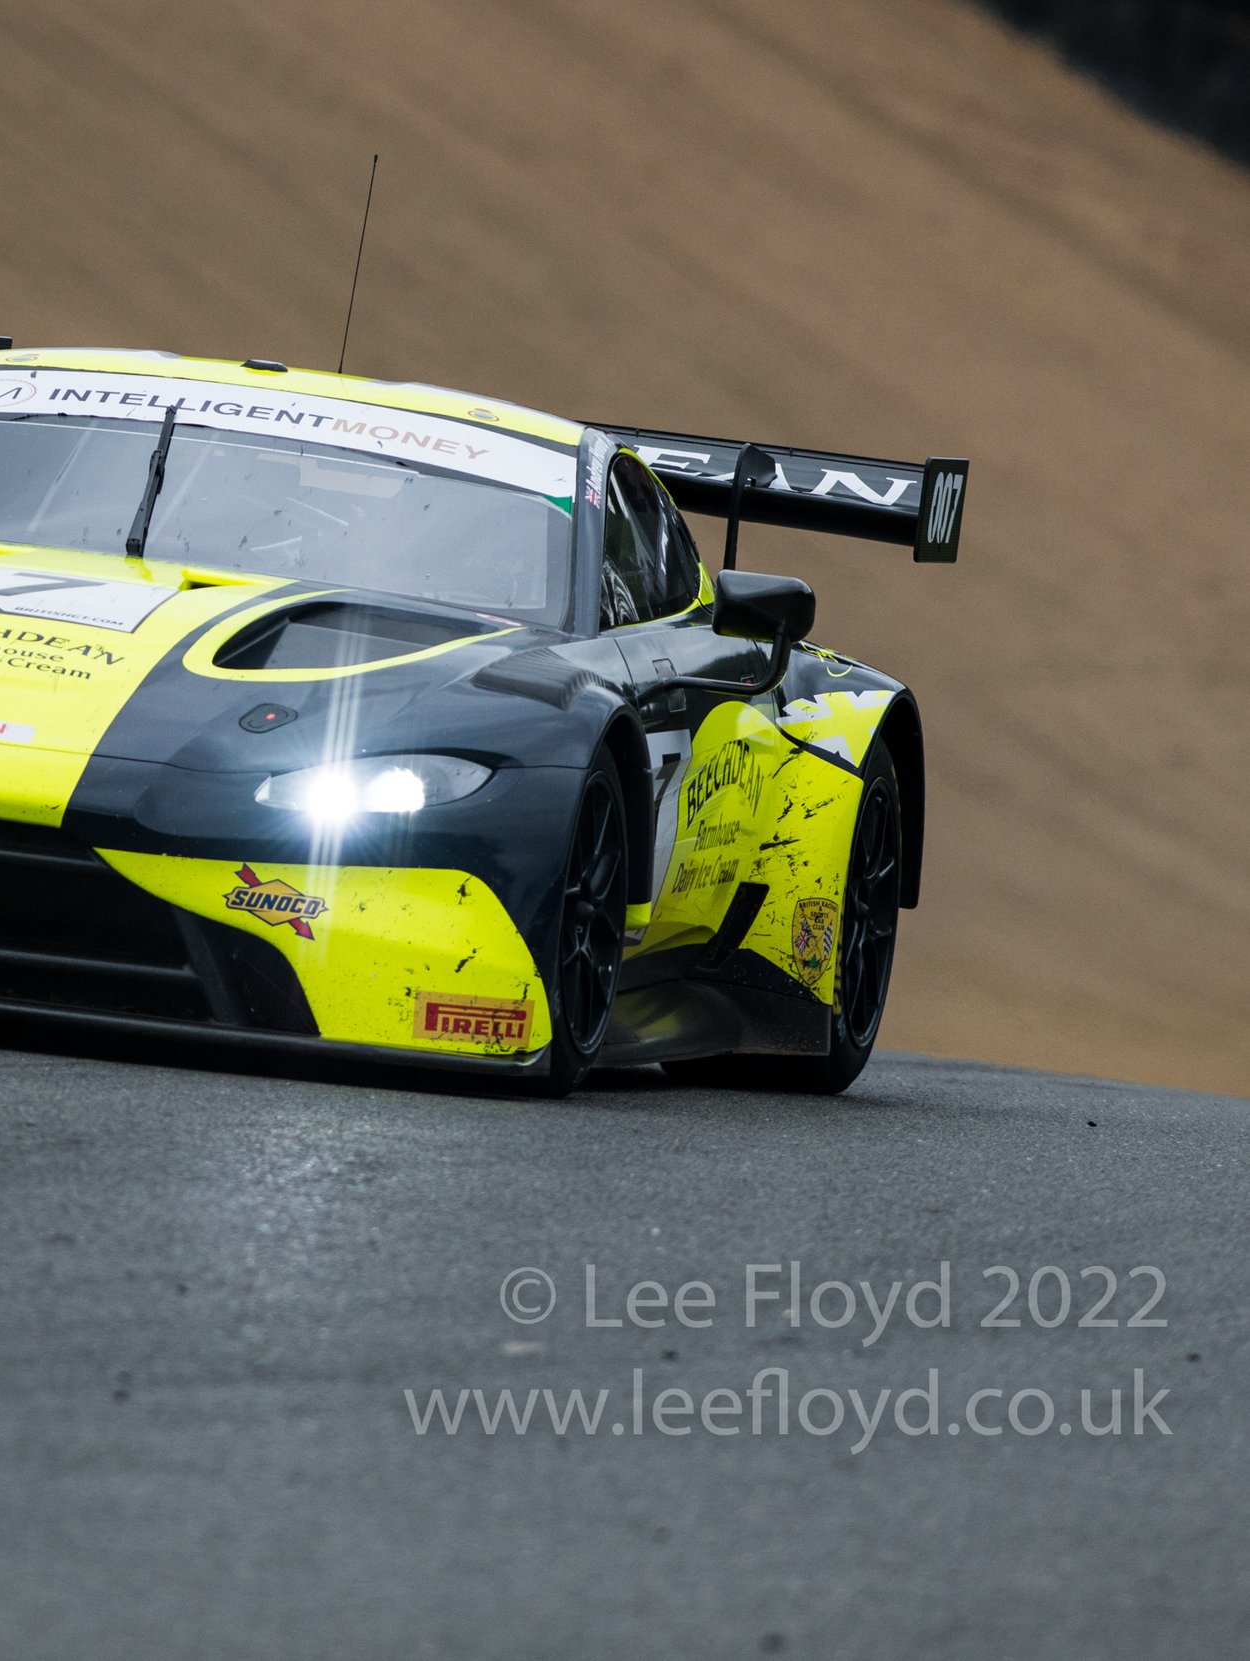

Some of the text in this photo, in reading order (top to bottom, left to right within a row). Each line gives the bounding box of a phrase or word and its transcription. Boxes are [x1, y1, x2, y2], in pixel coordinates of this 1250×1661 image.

[927, 471, 964, 545] 007
[7, 657, 92, 680] Cream
[686, 739, 765, 830] BEECHDEAN
[694, 811, 741, 852] Farmhouse
[671, 854, 740, 900] Dairy Ice Cream
[231, 889, 319, 915] SUNOCO
[424, 1001, 528, 1040] PIRELLI
